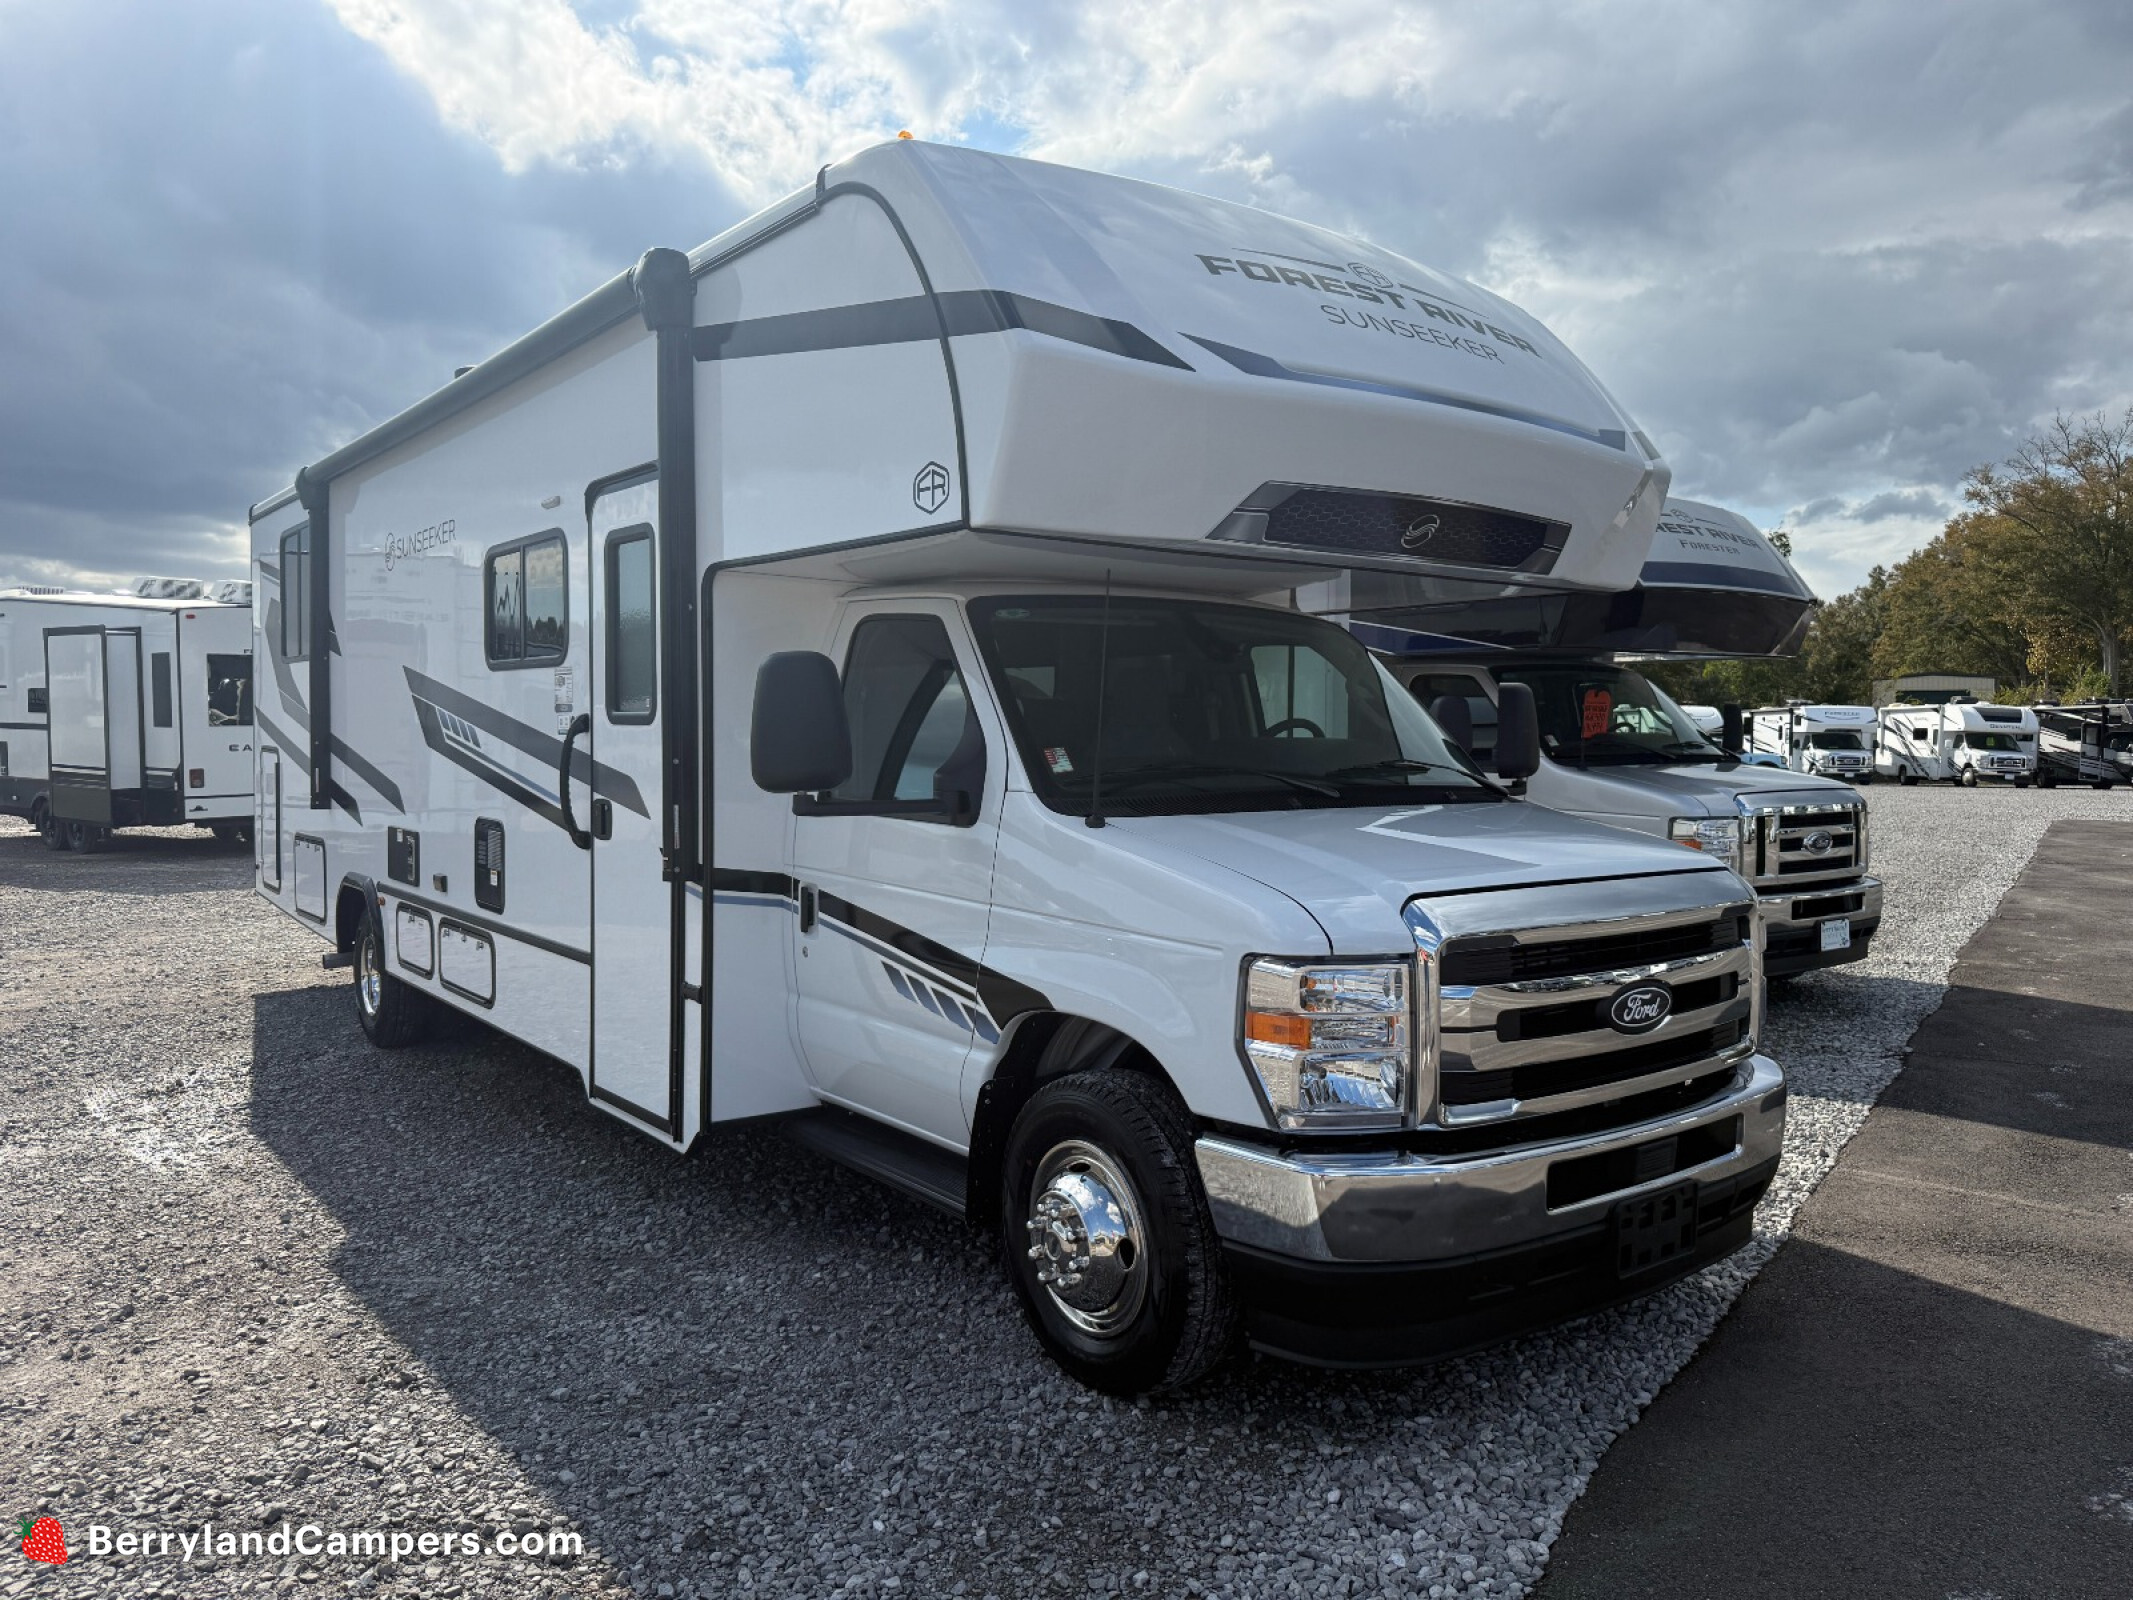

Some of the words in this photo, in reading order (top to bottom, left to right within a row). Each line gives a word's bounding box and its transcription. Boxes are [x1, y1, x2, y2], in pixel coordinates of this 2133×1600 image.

[1194, 253, 1406, 309] FOREST
[1412, 298, 1541, 358] RIVER
[1320, 304, 1504, 364] SUNSEEKER
[396, 519, 456, 559] SUNSEEKER
[1655, 522, 1704, 537] REST
[1707, 528, 1761, 549] RIVER
[229, 744, 252, 752] EA
[1623, 993, 1660, 1021] Ford
